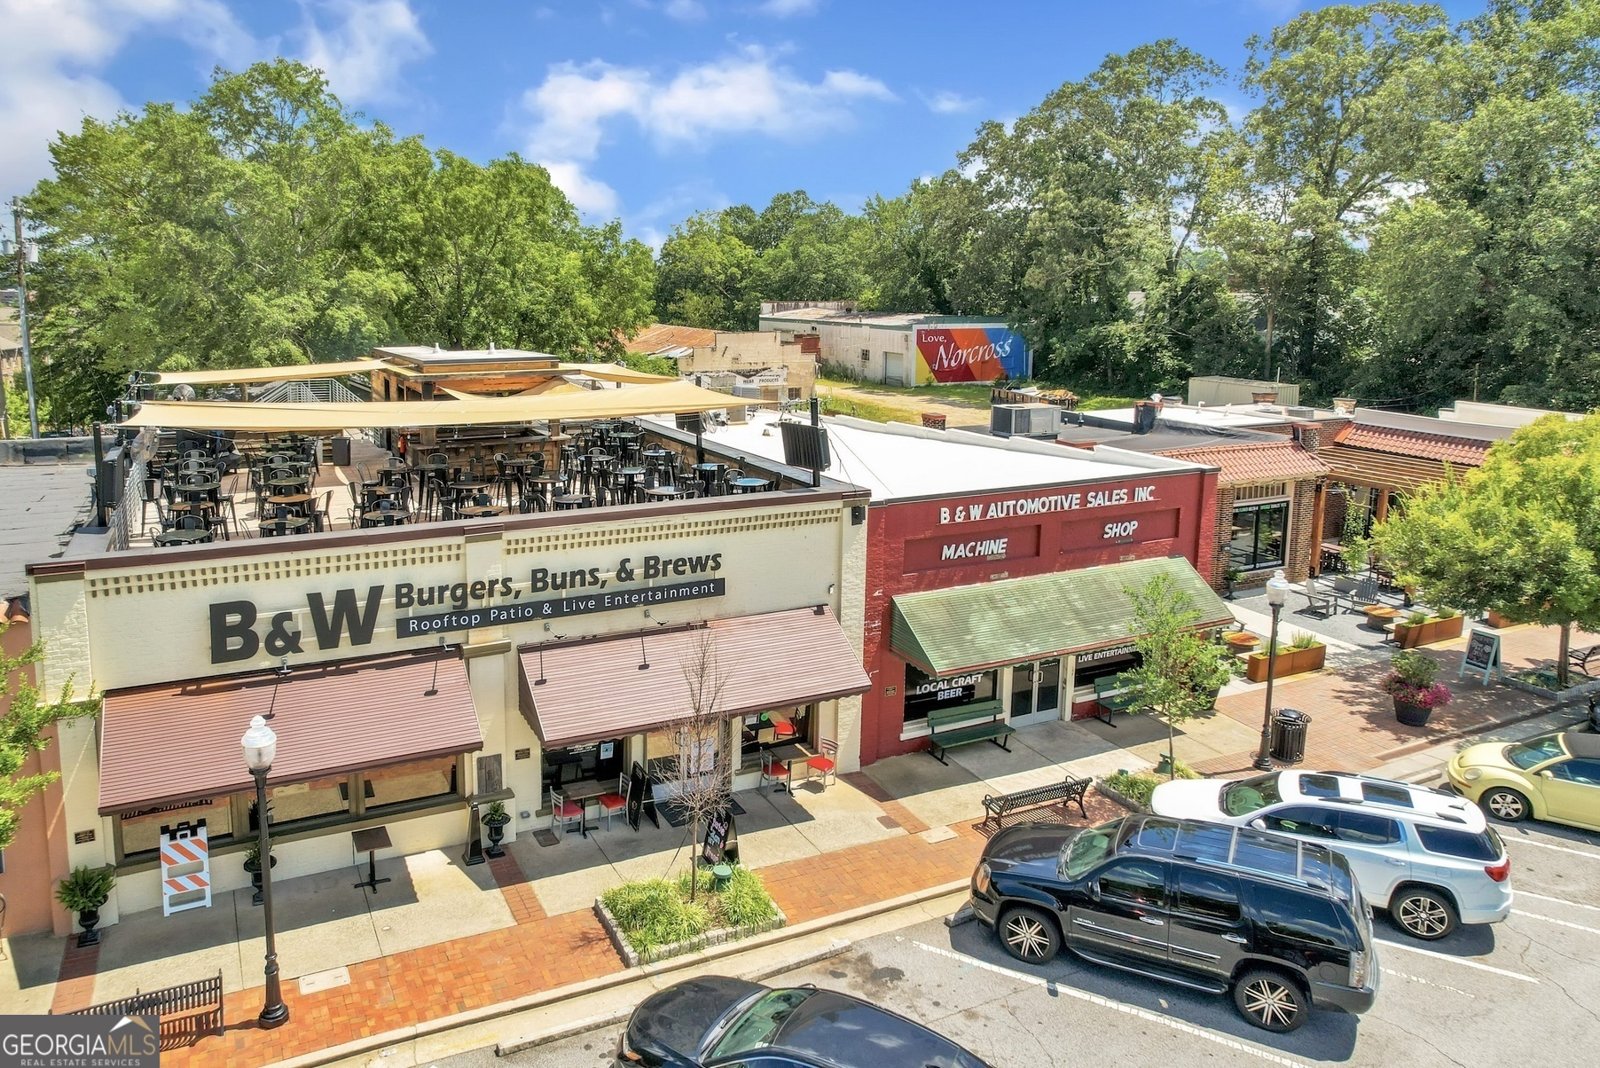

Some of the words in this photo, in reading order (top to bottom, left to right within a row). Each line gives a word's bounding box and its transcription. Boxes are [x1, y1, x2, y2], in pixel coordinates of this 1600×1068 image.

[922, 334, 947, 343] Love,
[932, 336, 1013, 371] Norcross
[940, 507, 950, 524] B
[954, 506, 965, 522] &
[969, 504, 983, 521] W
[986, 493, 1081, 519] AUTOMOTIVE
[1086, 488, 1128, 508] SALES
[1102, 520, 1139, 539] SHOP
[941, 538, 1009, 560] MACHINE
[395, 577, 523, 611] Burgers,
[531, 567, 609, 593] Buns,
[615, 557, 635, 583] &
[643, 552, 722, 580] Brews
[409, 612, 481, 632] Rooftop
[490, 606, 533, 621] Patio
[542, 603, 552, 615] &
[563, 598, 596, 613] Live
[604, 583, 715, 608] Entertainment
[1078, 653, 1093, 663] LIVE
[916, 679, 949, 695] LOCAL
[951, 673, 984, 689] CRAFT
[937, 687, 963, 701] BEER
